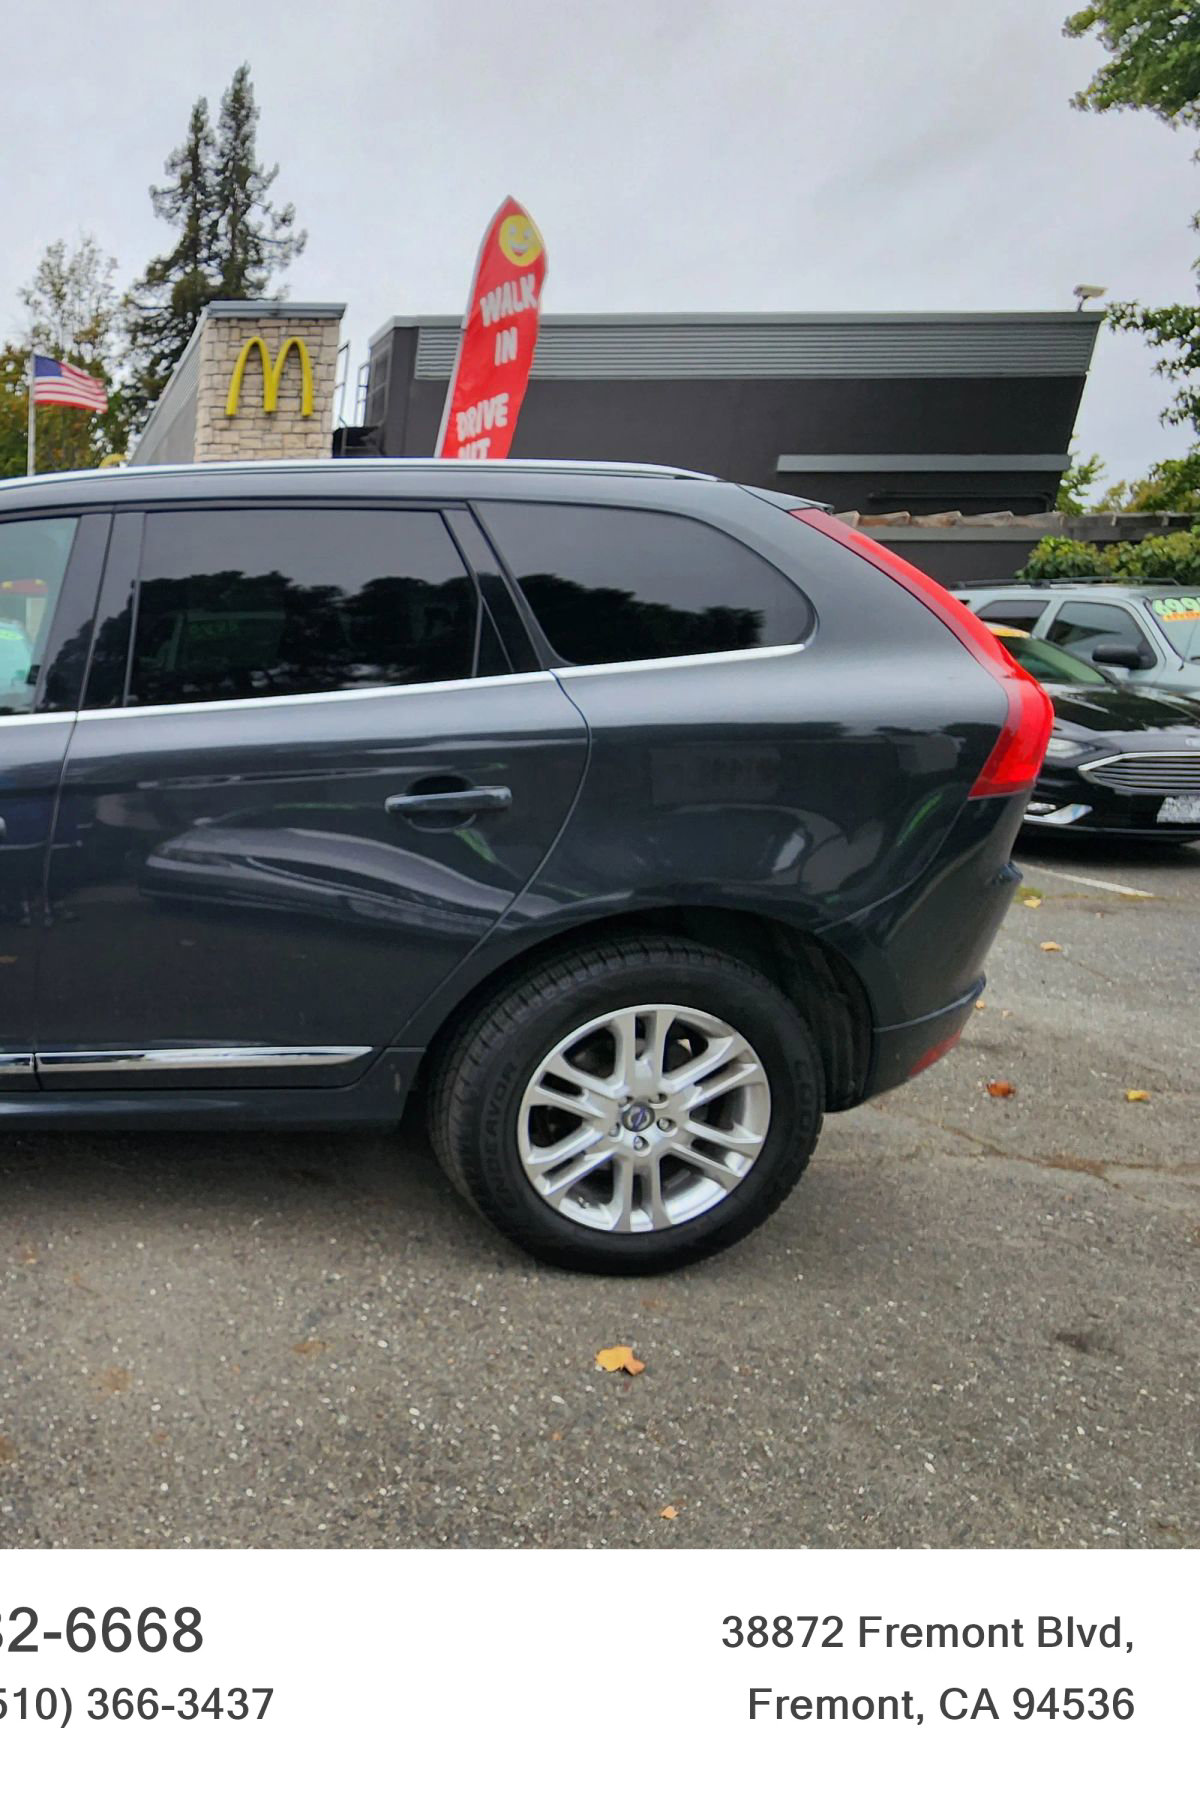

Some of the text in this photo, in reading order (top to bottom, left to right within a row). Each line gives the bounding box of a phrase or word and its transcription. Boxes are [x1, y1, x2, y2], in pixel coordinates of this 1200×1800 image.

[479, 273, 538, 328] WALK
[494, 326, 518, 367] IN
[456, 392, 509, 442] DRIVE
[1151, 596, 1200, 616] 699
